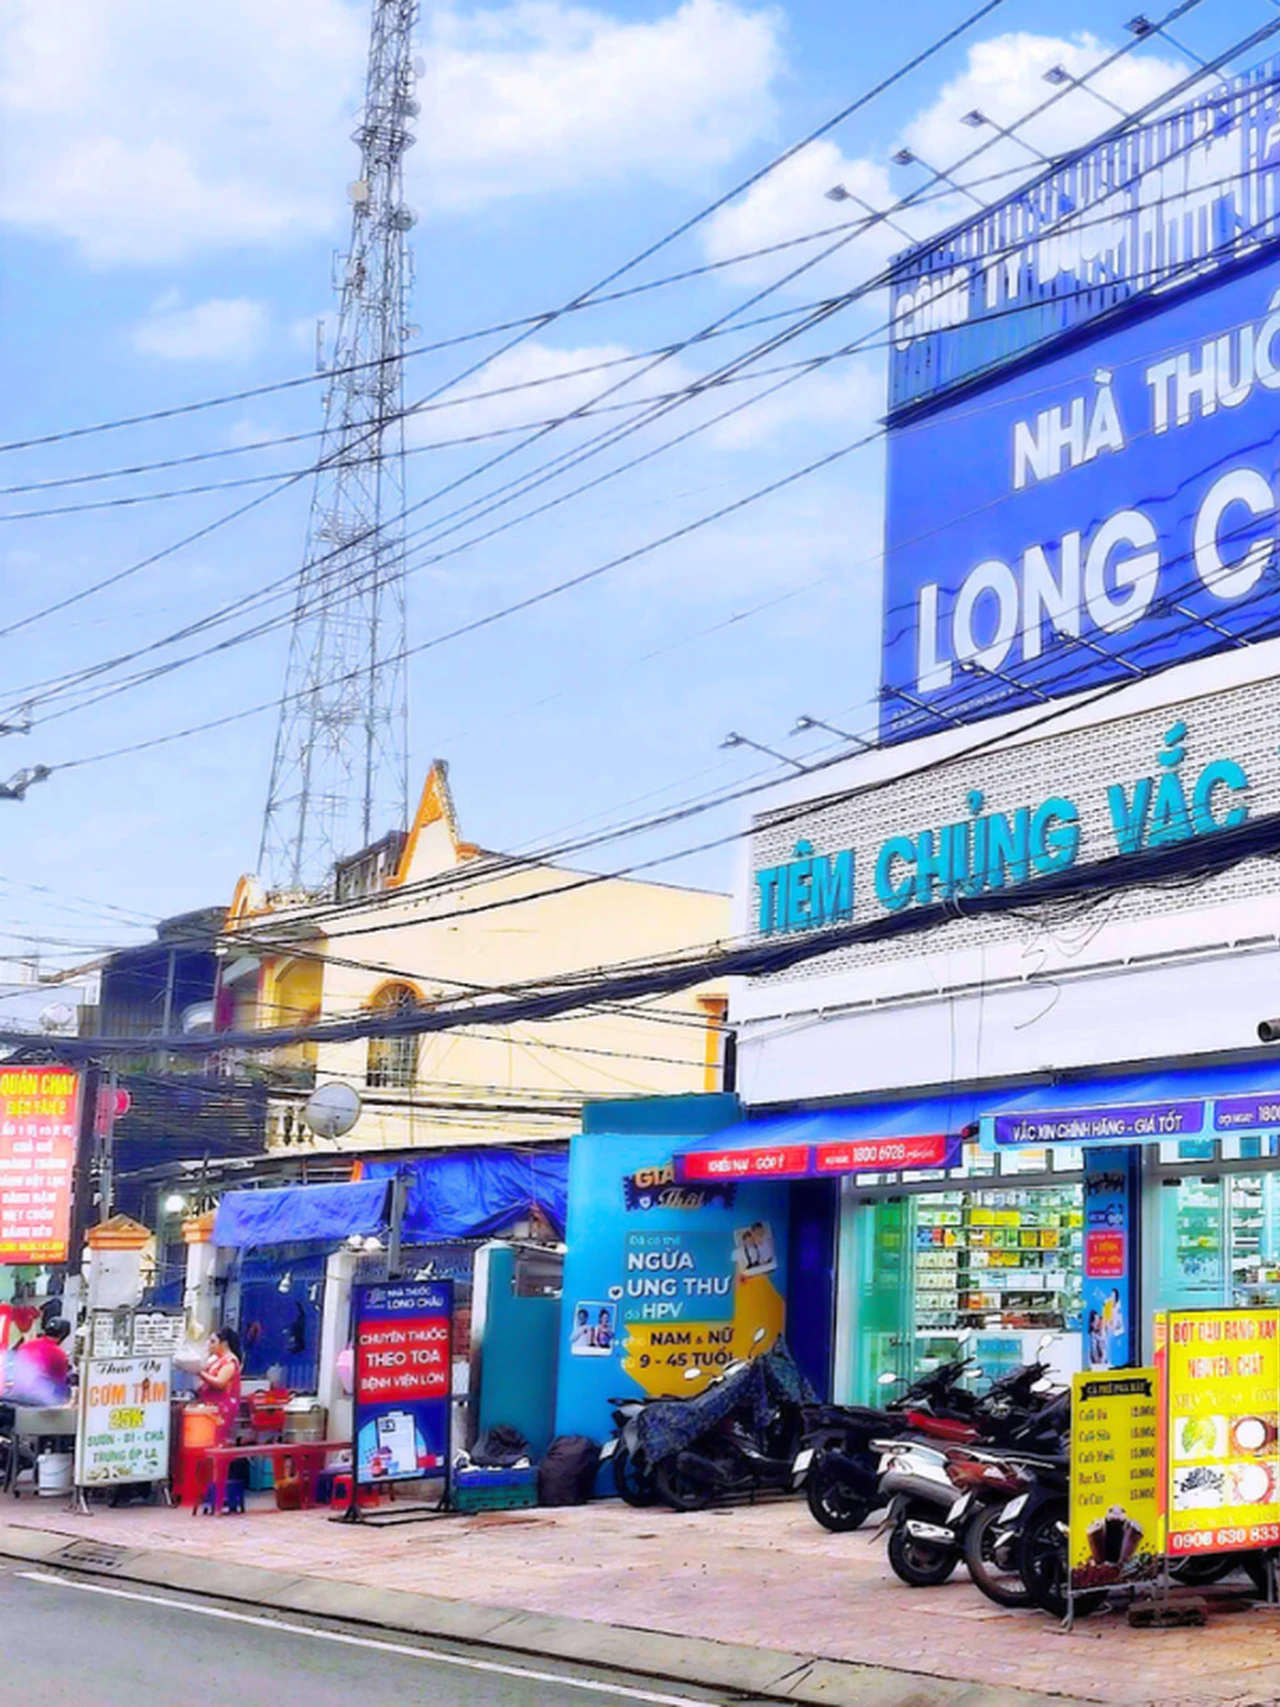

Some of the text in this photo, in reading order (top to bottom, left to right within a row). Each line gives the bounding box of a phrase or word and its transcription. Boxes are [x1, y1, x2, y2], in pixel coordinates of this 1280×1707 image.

[1013, 369, 1125, 491] NHÀ
[917, 508, 1161, 694] LONG
[755, 839, 855, 936] TIÊM
[875, 790, 1079, 910] CHỦNG
[1108, 721, 1248, 854] VẮC
[853, 1146, 877, 1163] 1800
[628, 1249, 694, 1271] NGỪA
[627, 1275, 733, 1297] UNG THƯ
[642, 1302, 684, 1319] HPV
[360, 1328, 447, 1345] CHUYÊN THUỐC
[650, 1331, 691, 1346] NAM
[709, 1327, 735, 1344] NỮ
[1173, 1318, 1195, 1347] BỘT
[366, 1349, 441, 1368] THEO TOA
[639, 1354, 650, 1368] 9
[666, 1352, 687, 1367] 45
